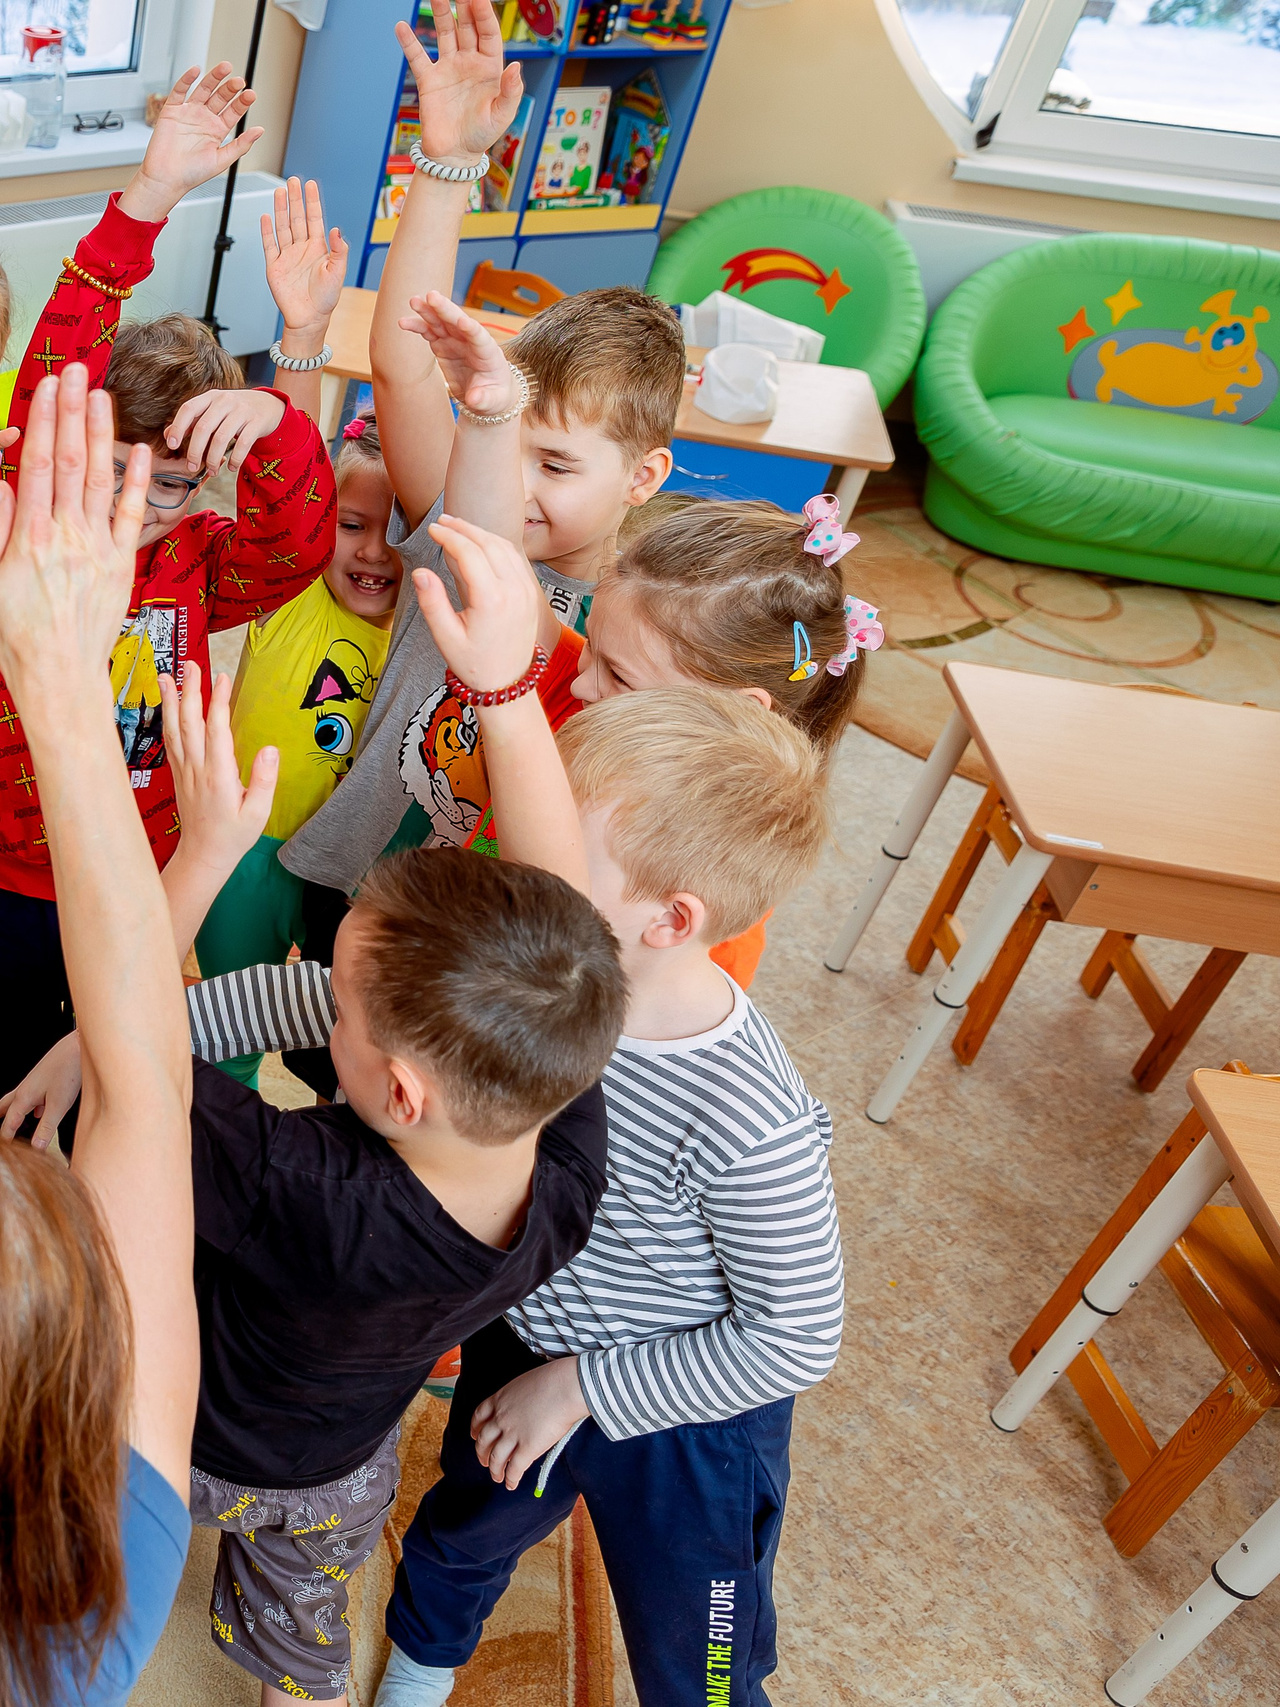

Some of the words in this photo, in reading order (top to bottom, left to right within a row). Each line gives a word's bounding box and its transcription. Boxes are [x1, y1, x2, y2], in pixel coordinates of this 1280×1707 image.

[546, 106, 577, 127] ТО
[178, 606, 188, 657] FRIEND
[218, 1491, 256, 1522] FROLIC
[709, 1580, 735, 1642] FUTURE
[707, 1643, 732, 1670] THE
